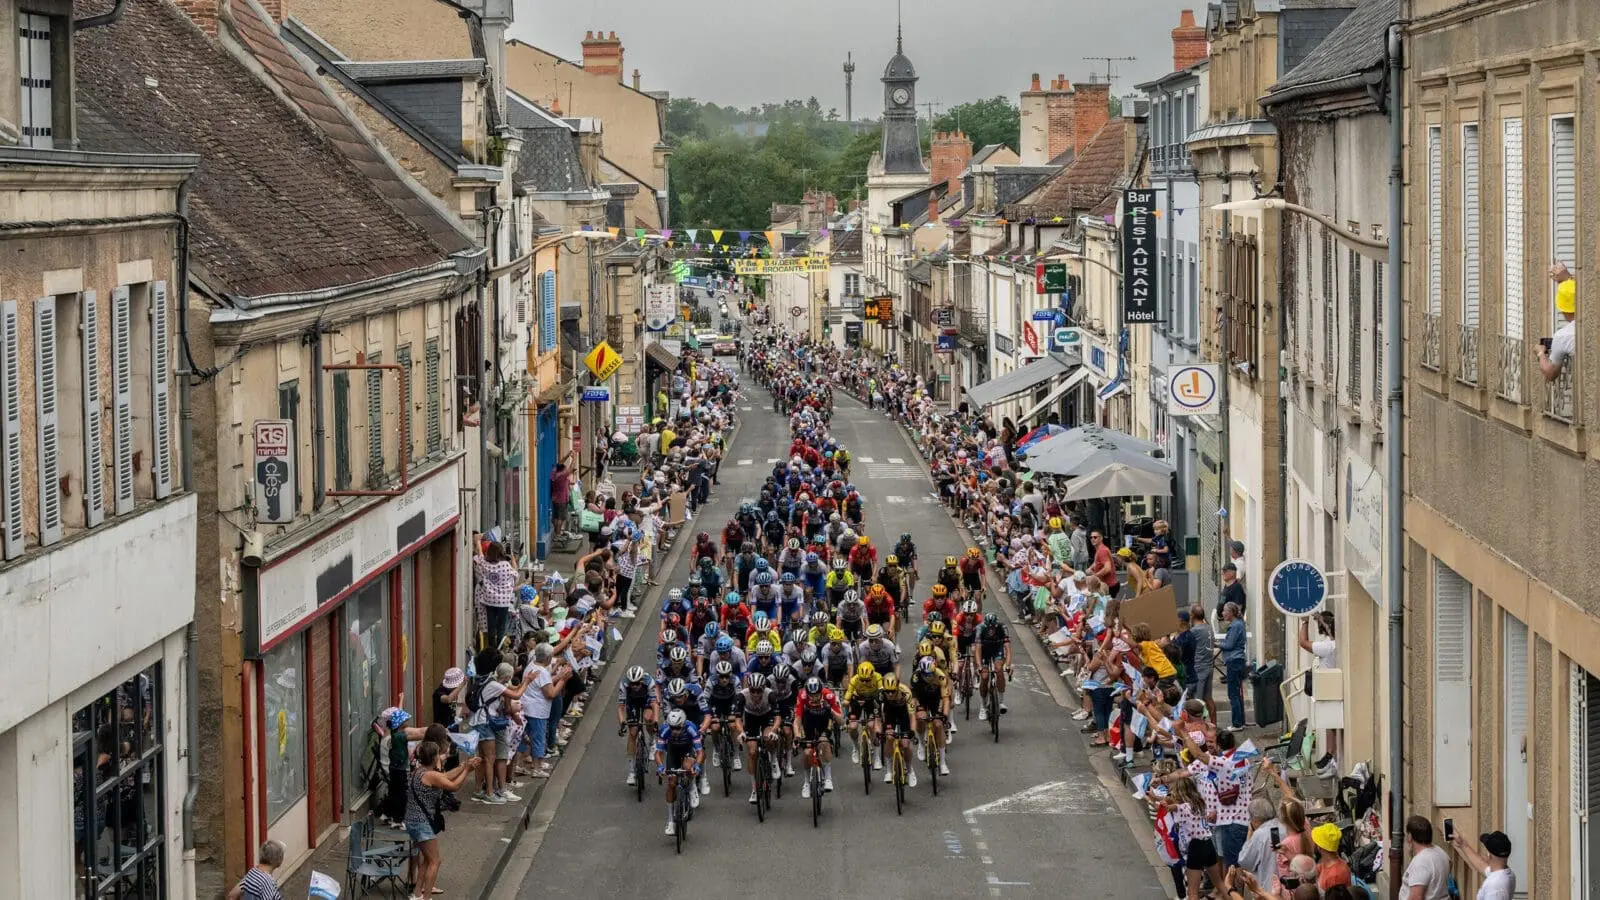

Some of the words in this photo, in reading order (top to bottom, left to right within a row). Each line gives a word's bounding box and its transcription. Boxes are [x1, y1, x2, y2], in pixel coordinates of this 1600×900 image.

[1127, 191, 1152, 203] Bar
[1132, 206, 1149, 306] RESTAURANT
[1127, 311, 1154, 321] Hôtel
[599, 358, 621, 378] PRESSE
[257, 447, 286, 456] minute
[265, 463, 282, 497] clés
[1286, 563, 1325, 589] CONDUITE
